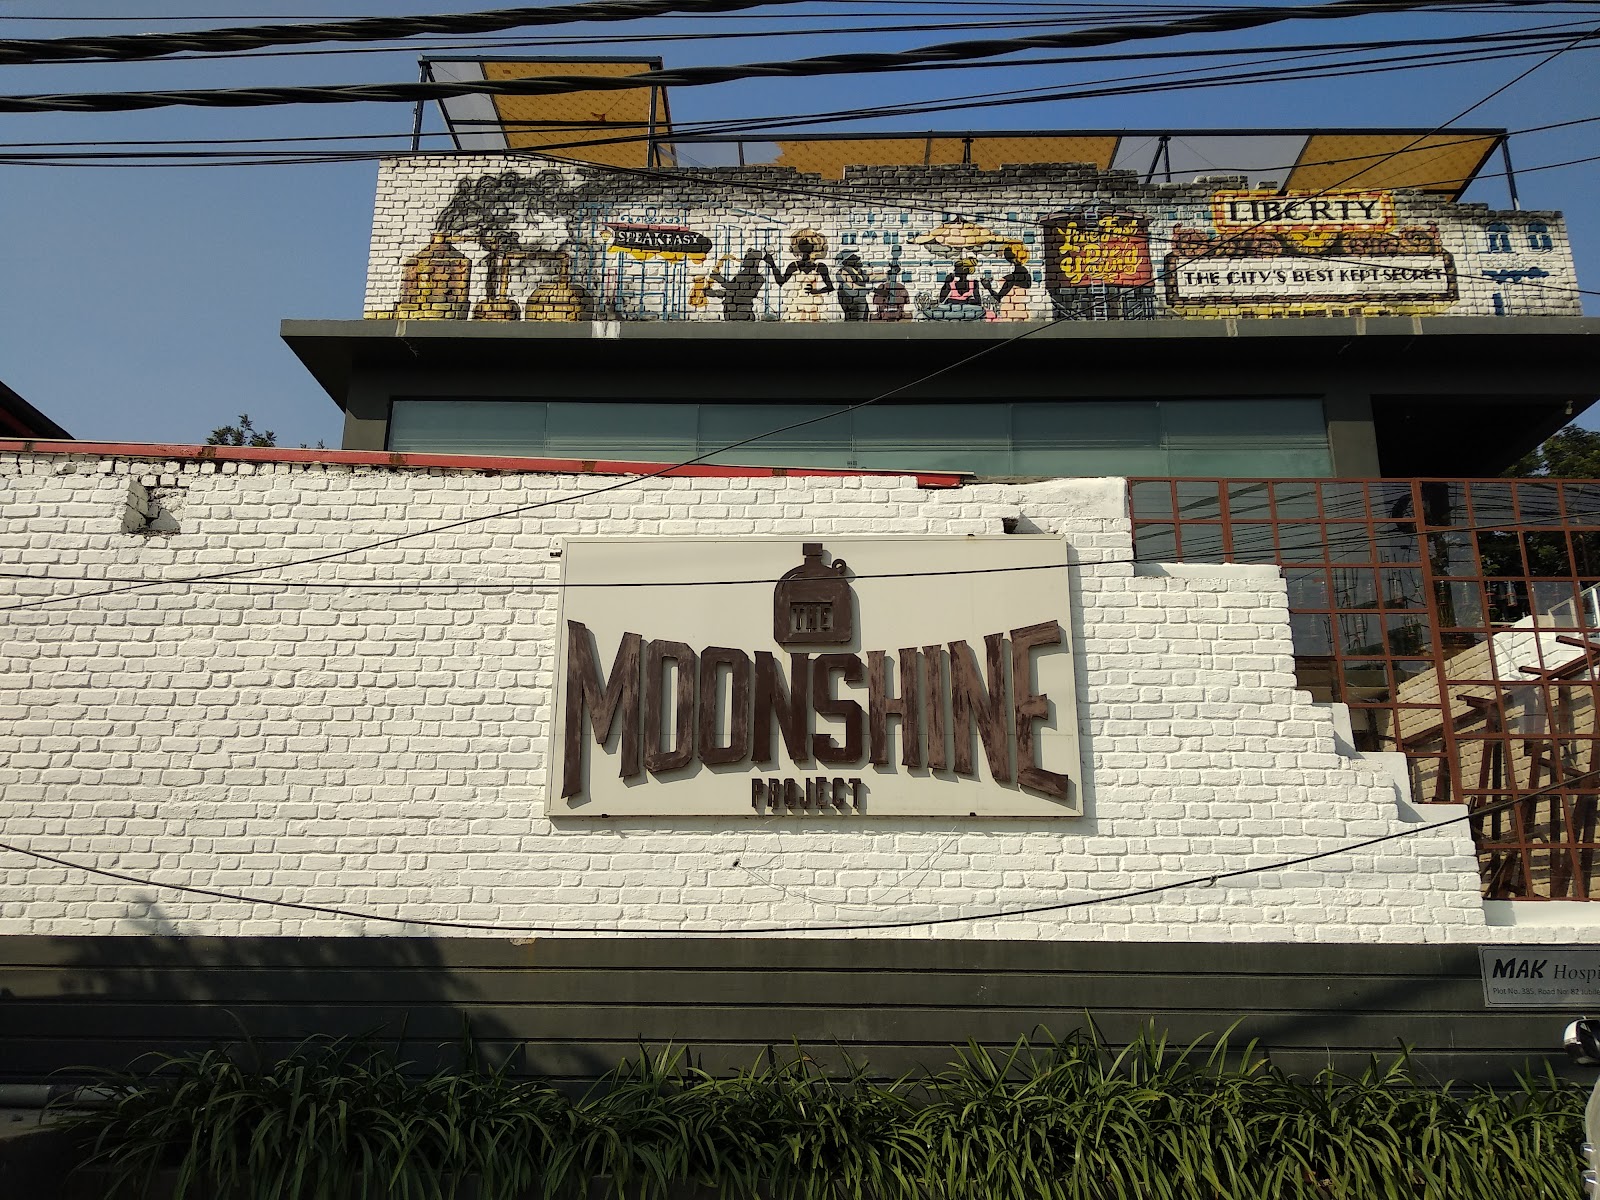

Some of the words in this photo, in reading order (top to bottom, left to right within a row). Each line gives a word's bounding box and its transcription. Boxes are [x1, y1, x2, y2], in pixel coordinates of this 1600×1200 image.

[1229, 200, 1378, 222] LIBERTY
[618, 230, 700, 247] SPEAKEASY
[1184, 271, 1220, 285] THE
[1226, 270, 1287, 285] CITY'S
[1292, 269, 1335, 283] BEST
[1340, 269, 1380, 283] KEPT
[1383, 268, 1443, 281] SECRET
[792, 604, 832, 631] THE
[561, 620, 1069, 798] MOONSHINE
[751, 777, 862, 809] PROJECT
[1493, 957, 1548, 979] MAK
[1493, 987, 1506, 995] Plot
[1538, 987, 1555, 995] Road
